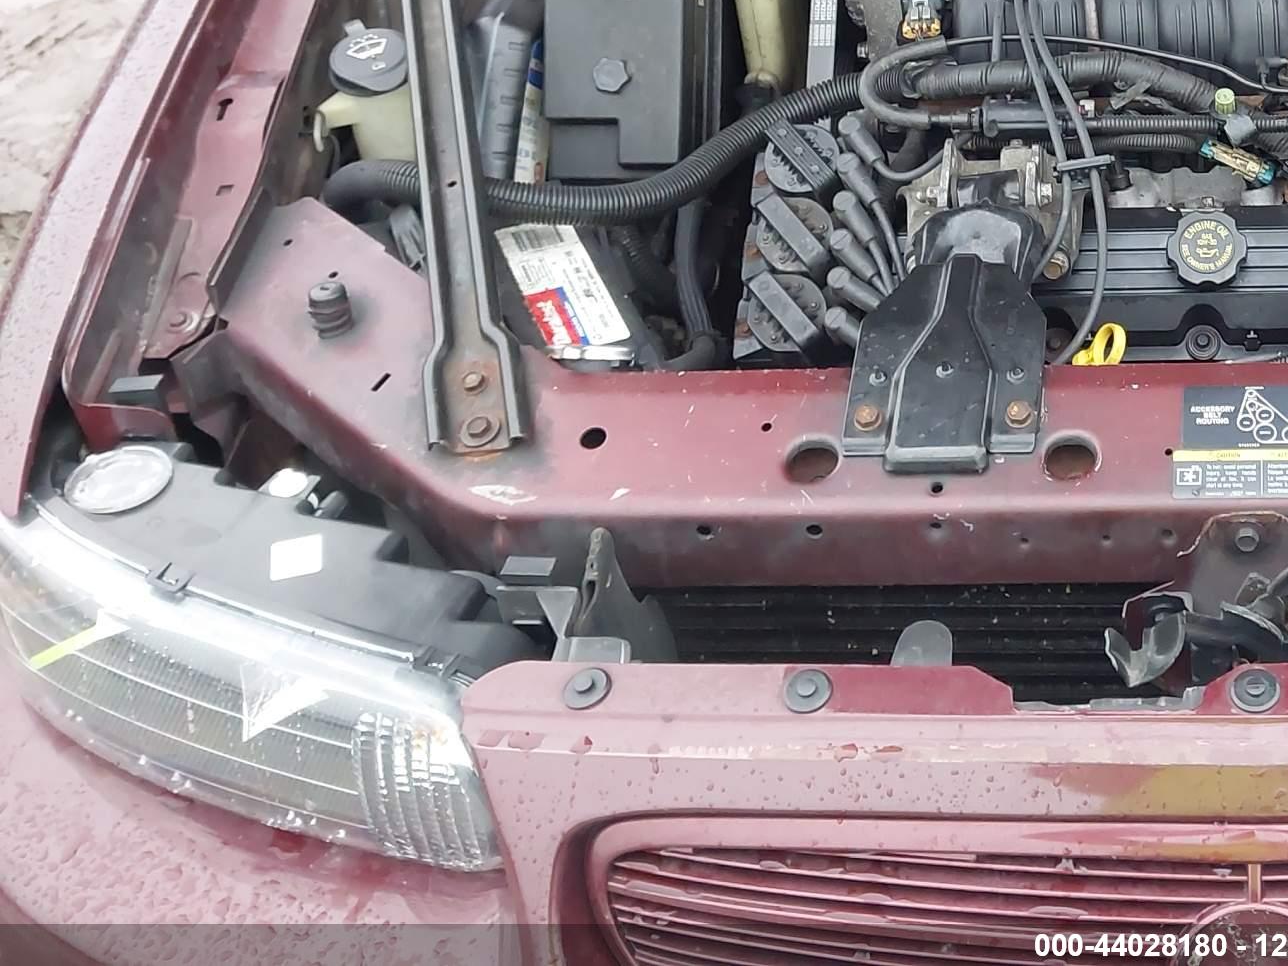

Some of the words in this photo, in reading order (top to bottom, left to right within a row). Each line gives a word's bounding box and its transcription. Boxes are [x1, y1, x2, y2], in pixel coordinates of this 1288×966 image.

[1184, 221, 1217, 239] ENGINE
[1217, 225, 1229, 240] OIL
[1190, 405, 1235, 413] ACCESSORY
